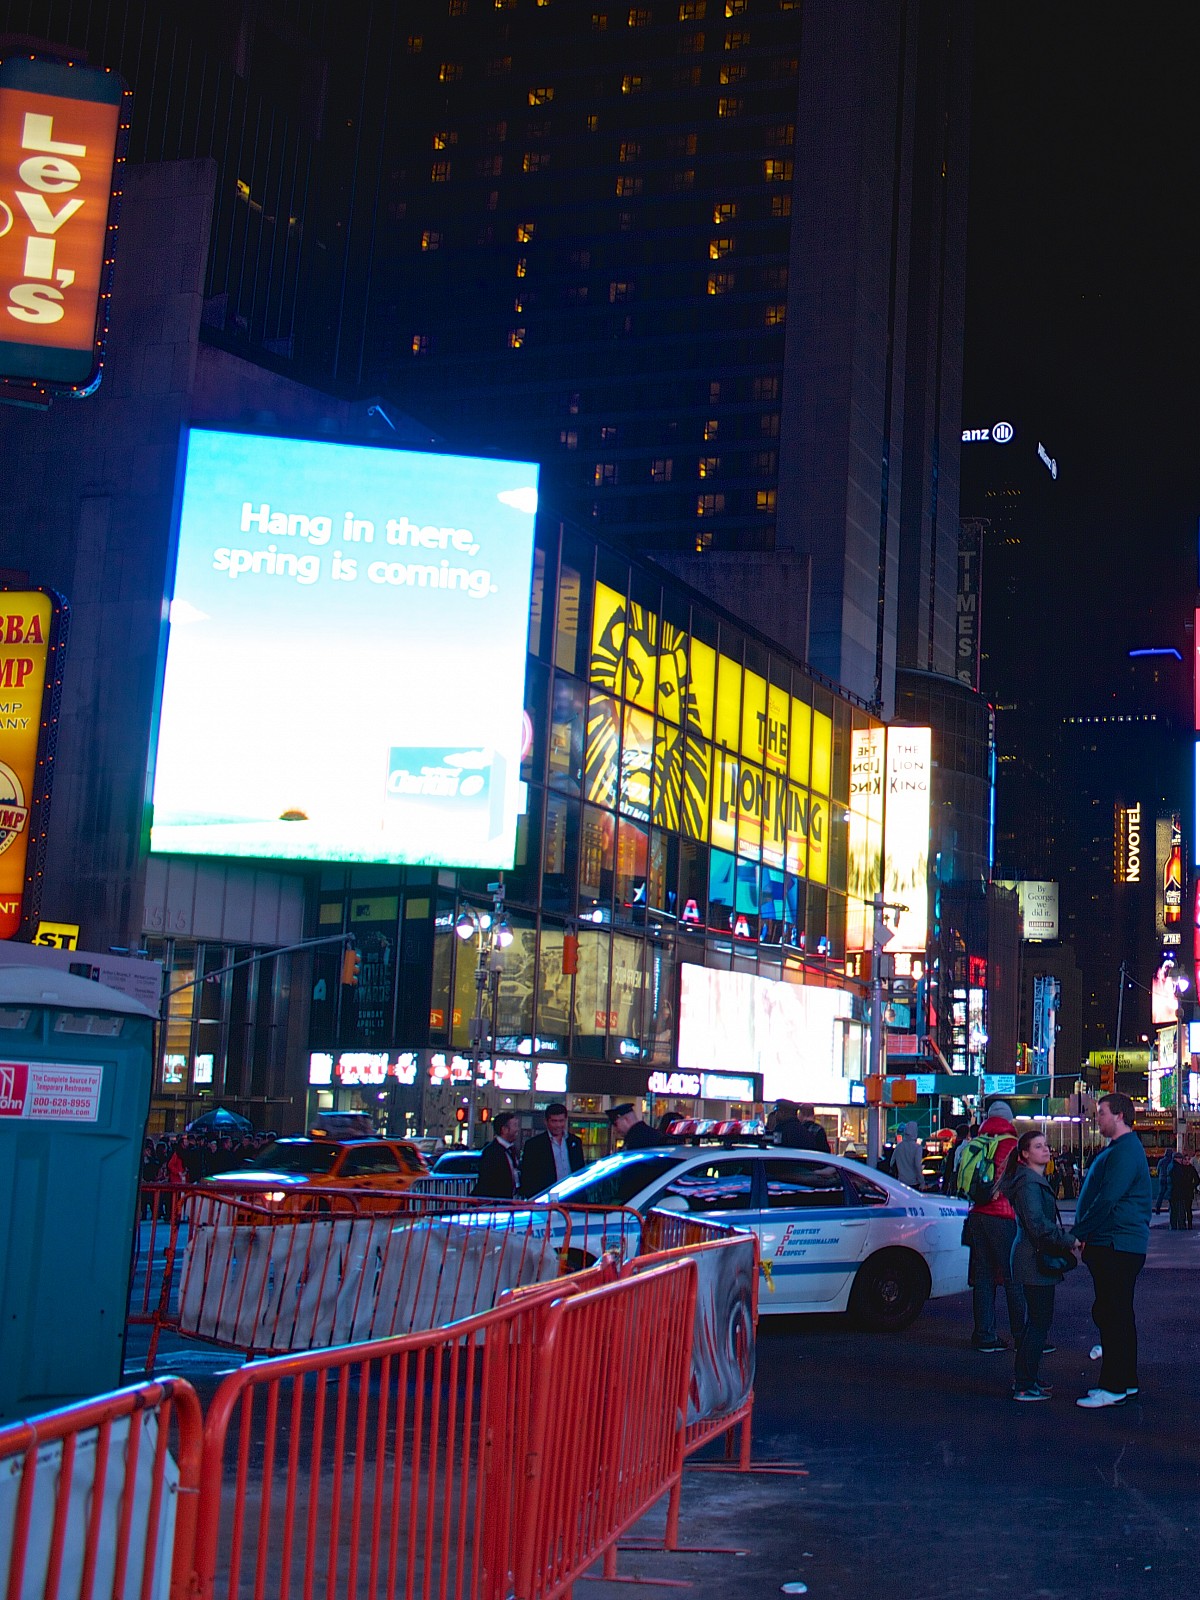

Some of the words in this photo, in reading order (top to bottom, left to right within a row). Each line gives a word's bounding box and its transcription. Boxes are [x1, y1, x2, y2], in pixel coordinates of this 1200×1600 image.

[962, 429, 989, 441] anz
[240, 502, 332, 546] Hang
[343, 511, 374, 543] in
[386, 517, 480, 556] there,
[212, 544, 320, 584] spring
[331, 550, 357, 581] is
[367, 559, 498, 599] coming.
[0, 614, 44, 645] BA
[756, 711, 787, 757] THE
[896, 745, 919, 754] THE
[892, 758, 924, 773] LION
[719, 739, 770, 822] LION
[773, 766, 822, 843] KING
[890, 777, 927, 794] KING
[0, 810, 24, 829] MP
[1126, 801, 1140, 881] NOVOTEL
[1037, 885, 1046, 894] By
[1031, 909, 1043, 917] did
[358, 1010, 383, 1018] SUNDAY
[356, 1019, 375, 1028] APRIL
[336, 1063, 409, 1076] OAKLEY
[44, 1075, 68, 1084] Complete
[69, 1075, 87, 1084] Source
[36, 1083, 63, 1092] Temporary
[64, 1084, 92, 1092] Restrooms
[33, 1097, 91, 1107] 800-628-8955
[32, 1108, 89, 1116] www.mrjohn.com
[786, 1224, 821, 1235] COURTESY
[781, 1235, 840, 1246] PROFESSIONALISM
[775, 1246, 806, 1256] RESPECT
